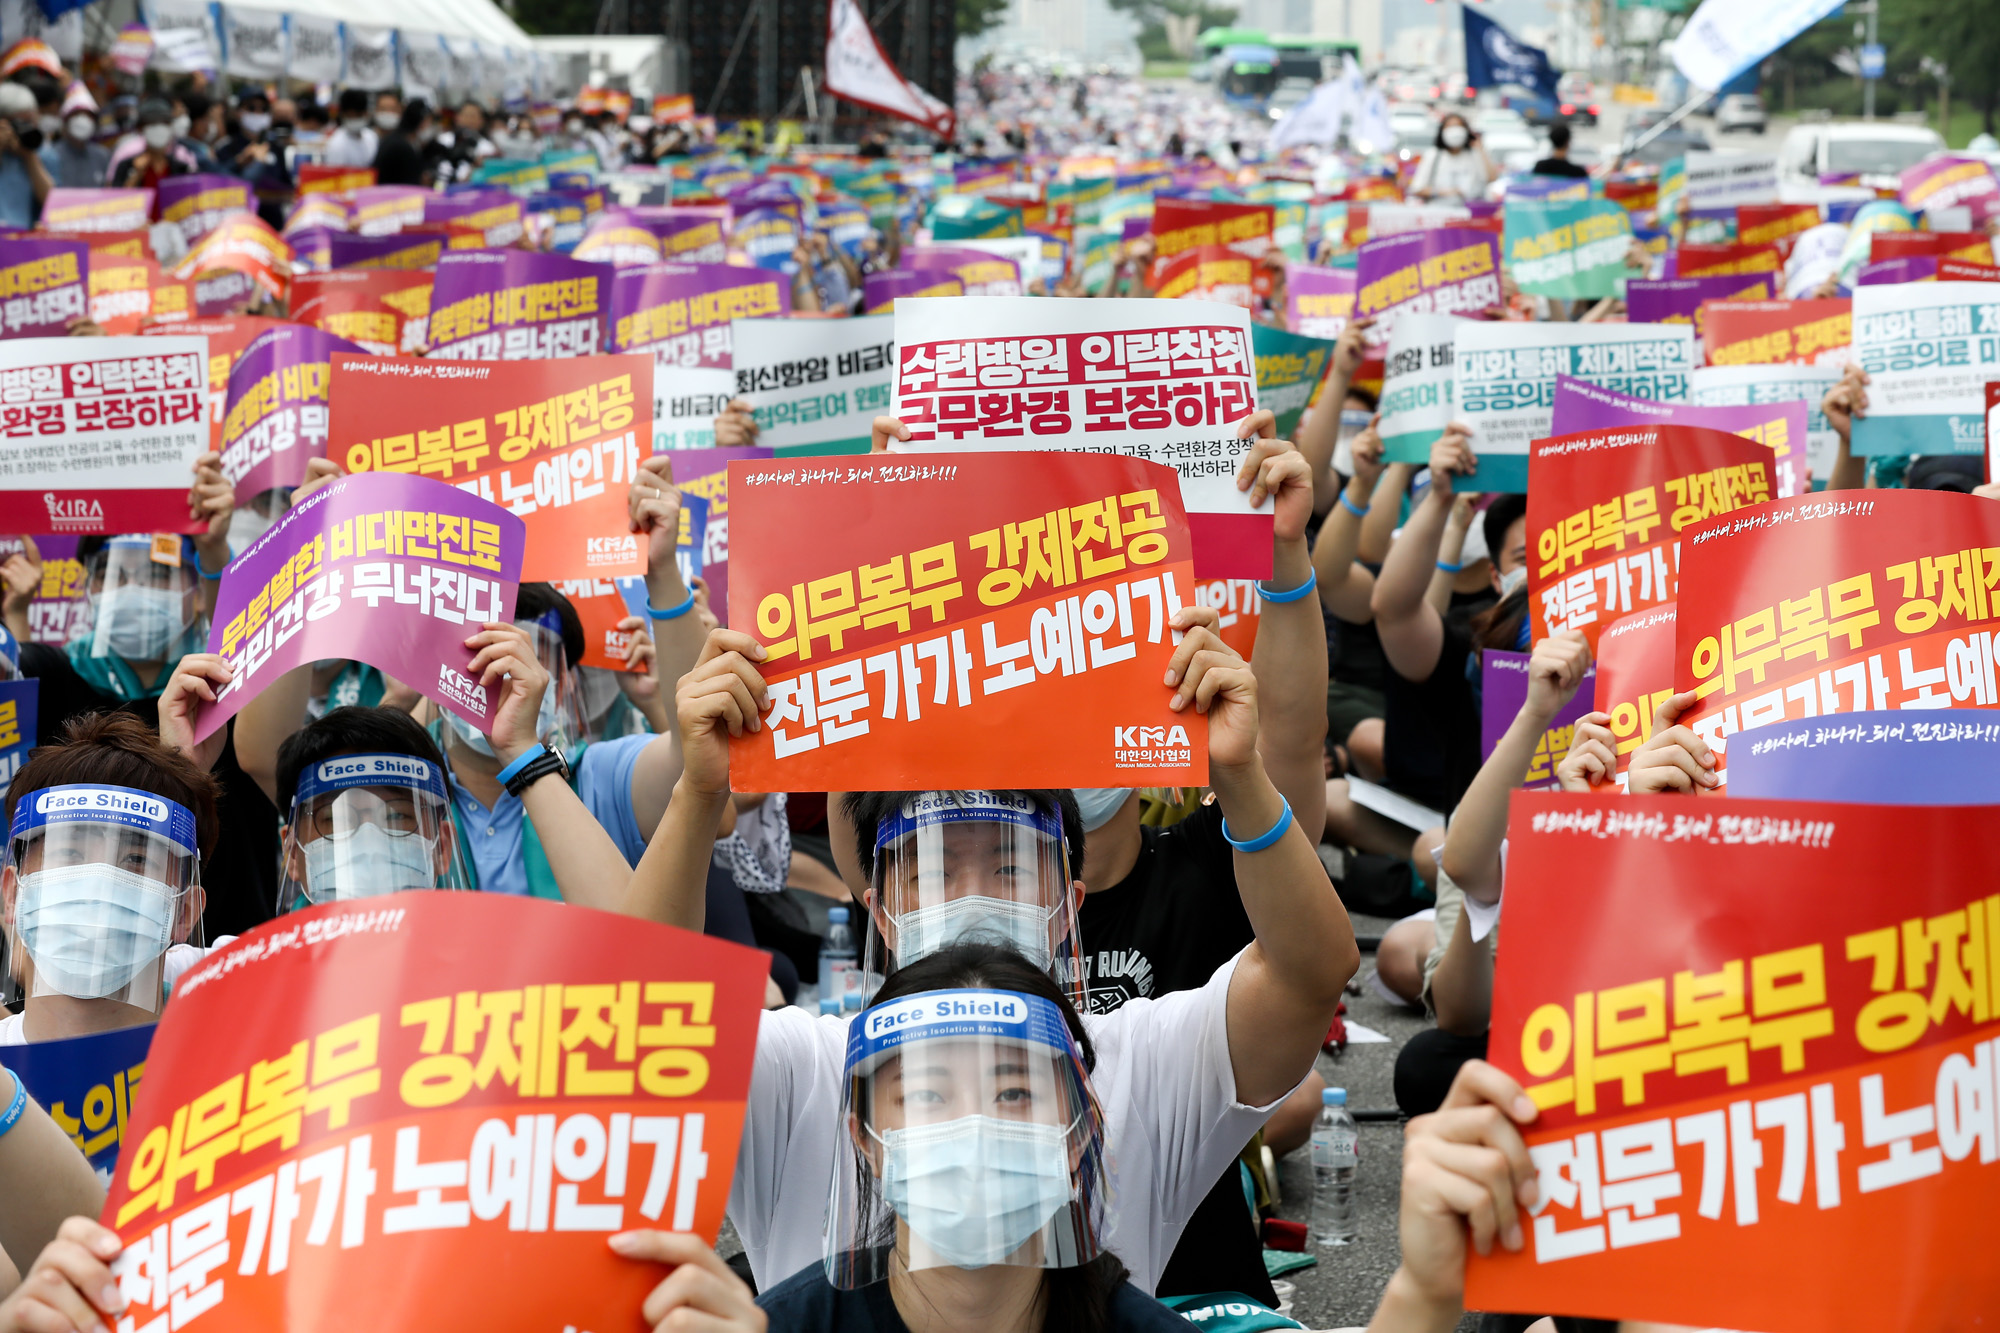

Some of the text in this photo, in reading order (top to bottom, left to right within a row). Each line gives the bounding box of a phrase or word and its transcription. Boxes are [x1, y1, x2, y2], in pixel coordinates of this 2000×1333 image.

[504, 318, 600, 358] 무너진다
[1578, 340, 1689, 375] 체계적인
[1861, 338, 1971, 374] 공공의료
[0, 365, 63, 404] 병원
[69, 353, 202, 390] 인력착취
[736, 351, 829, 395] 최신항암
[901, 337, 1069, 393] 수련병원
[1080, 328, 1251, 382] 인력착취
[0, 394, 203, 438] 환경 보장하라
[346, 417, 490, 479] 의무복무
[494, 373, 635, 463] 강제전공
[899, 381, 1256, 442] 근무환경 보장하라
[500, 431, 641, 518] 노예인가
[1176, 459, 1237, 479] 개선하라
[45, 493, 104, 518] KIRA
[1538, 461, 1770, 580] 의무복무 강제전공
[586, 536, 638, 554] KMA
[219, 510, 502, 659] 무분별한 비대면진료
[755, 540, 964, 665] 의무복무
[968, 488, 1170, 608] 강제전공
[1541, 544, 1669, 636] 전문가가
[216, 561, 503, 704] 국민건강 무너진다
[1690, 571, 1881, 701] 의무복무
[440, 663, 488, 705] KMA
[763, 570, 1186, 761] 전문가가 노예인가
[1897, 630, 2000, 711] 노예
[1114, 725, 1191, 747] KMA
[1114, 749, 1191, 762] 대한의사협회
[324, 759, 425, 778] Face Shield
[333, 778, 370, 788] Protective
[44, 793, 161, 818] Face Shield
[48, 812, 152, 828] Protective Isolation Mask
[911, 795, 955, 813] Face
[961, 811, 999, 819] Isolation
[1001, 812, 1023, 822] Mask
[872, 1000, 1016, 1033] Face Shield
[882, 1024, 1005, 1047] Protective Isolation Mask
[1520, 943, 1834, 1116] 의무복무
[115, 1014, 382, 1230] 의무복무
[398, 980, 717, 1109] 강제전공
[1528, 1082, 1845, 1264] 전문가가
[108, 1112, 709, 1333] 전문가가 노예인가
